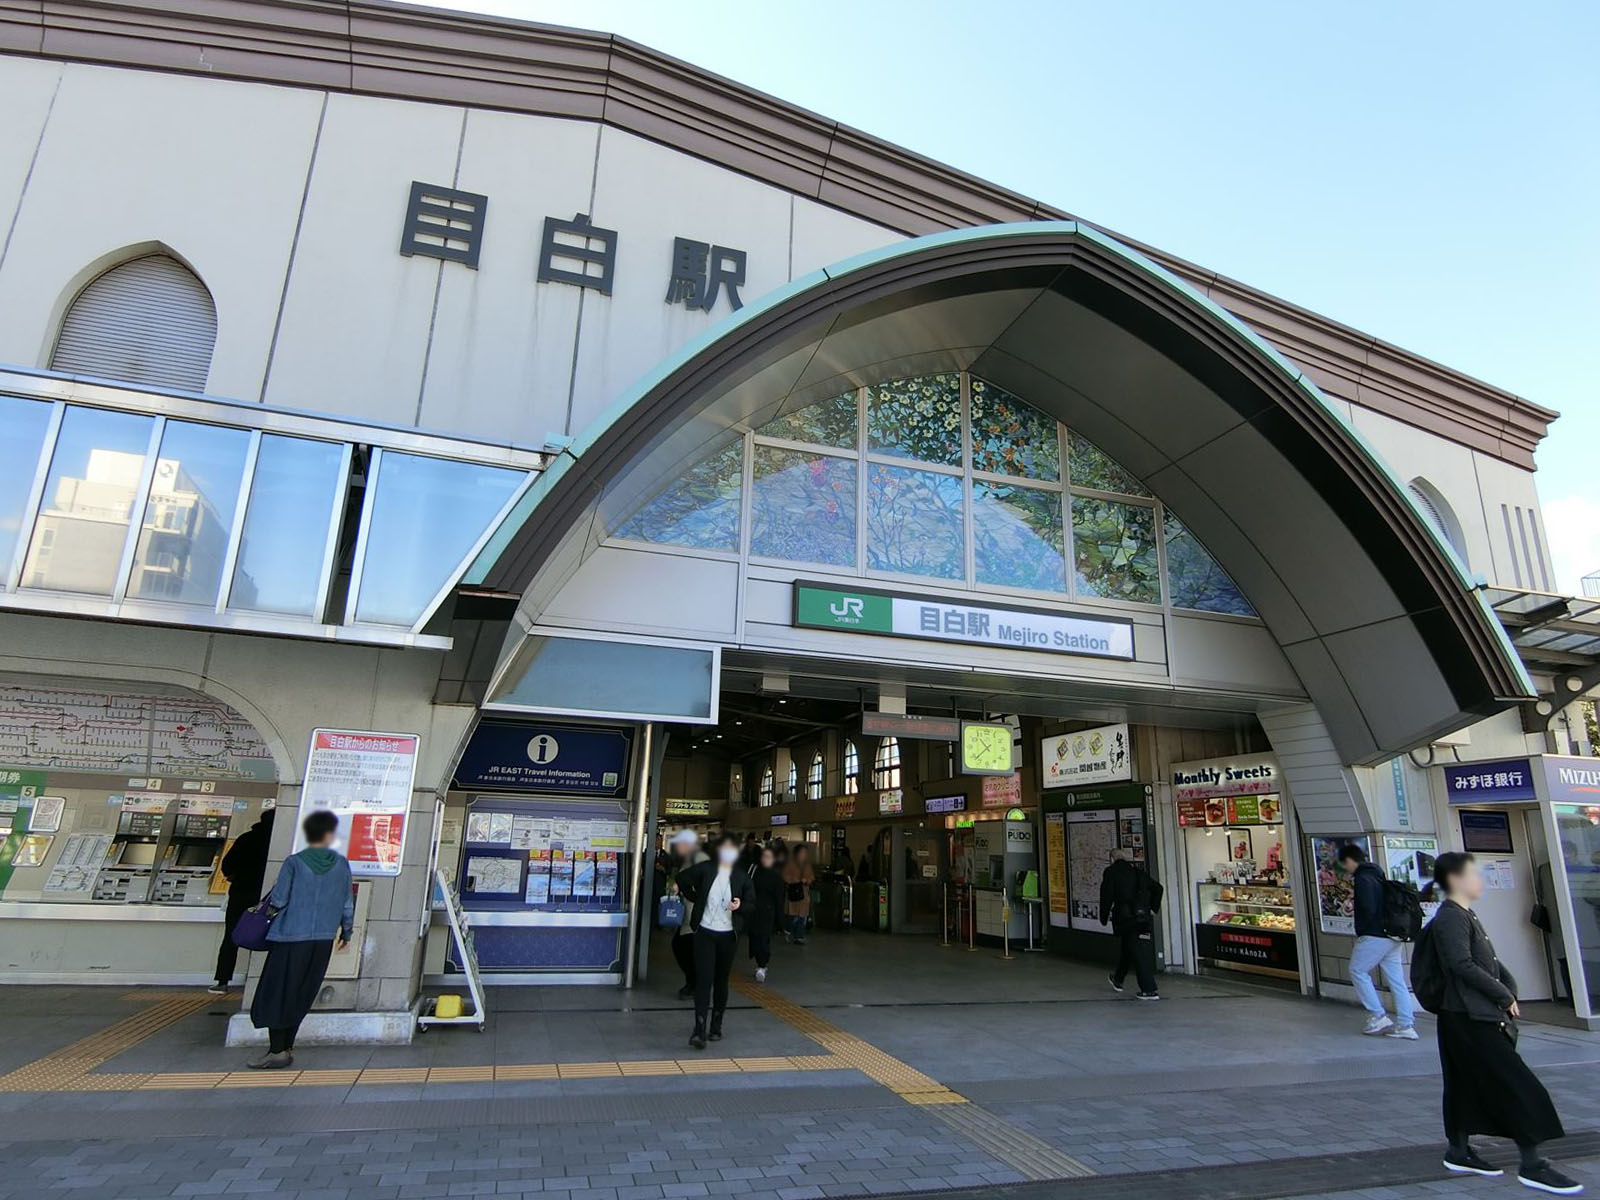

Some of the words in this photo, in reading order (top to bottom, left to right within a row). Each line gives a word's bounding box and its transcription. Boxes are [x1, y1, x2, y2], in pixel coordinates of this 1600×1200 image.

[400, 180, 747, 315] 目白駅
[830, 597, 864, 618] JR
[920, 606, 991, 638] 目白駅
[998, 624, 1049, 646] Mejiro
[1053, 631, 1109, 651] Station
[488, 766, 500, 774] JR
[500, 767, 523, 775] EAST
[524, 768, 547, 777] Travel
[548, 769, 591, 779] Information
[1174, 767, 1221, 786] Monthly
[1225, 765, 1272, 781] Sweets
[150, 780, 158, 789] 4
[204, 782, 212, 791] 3
[1455, 771, 1523, 790] みずほ銀行
[24, 787, 32, 797] 5
[264, 799, 272, 808] 2
[1008, 831, 1031, 841] PUDO
